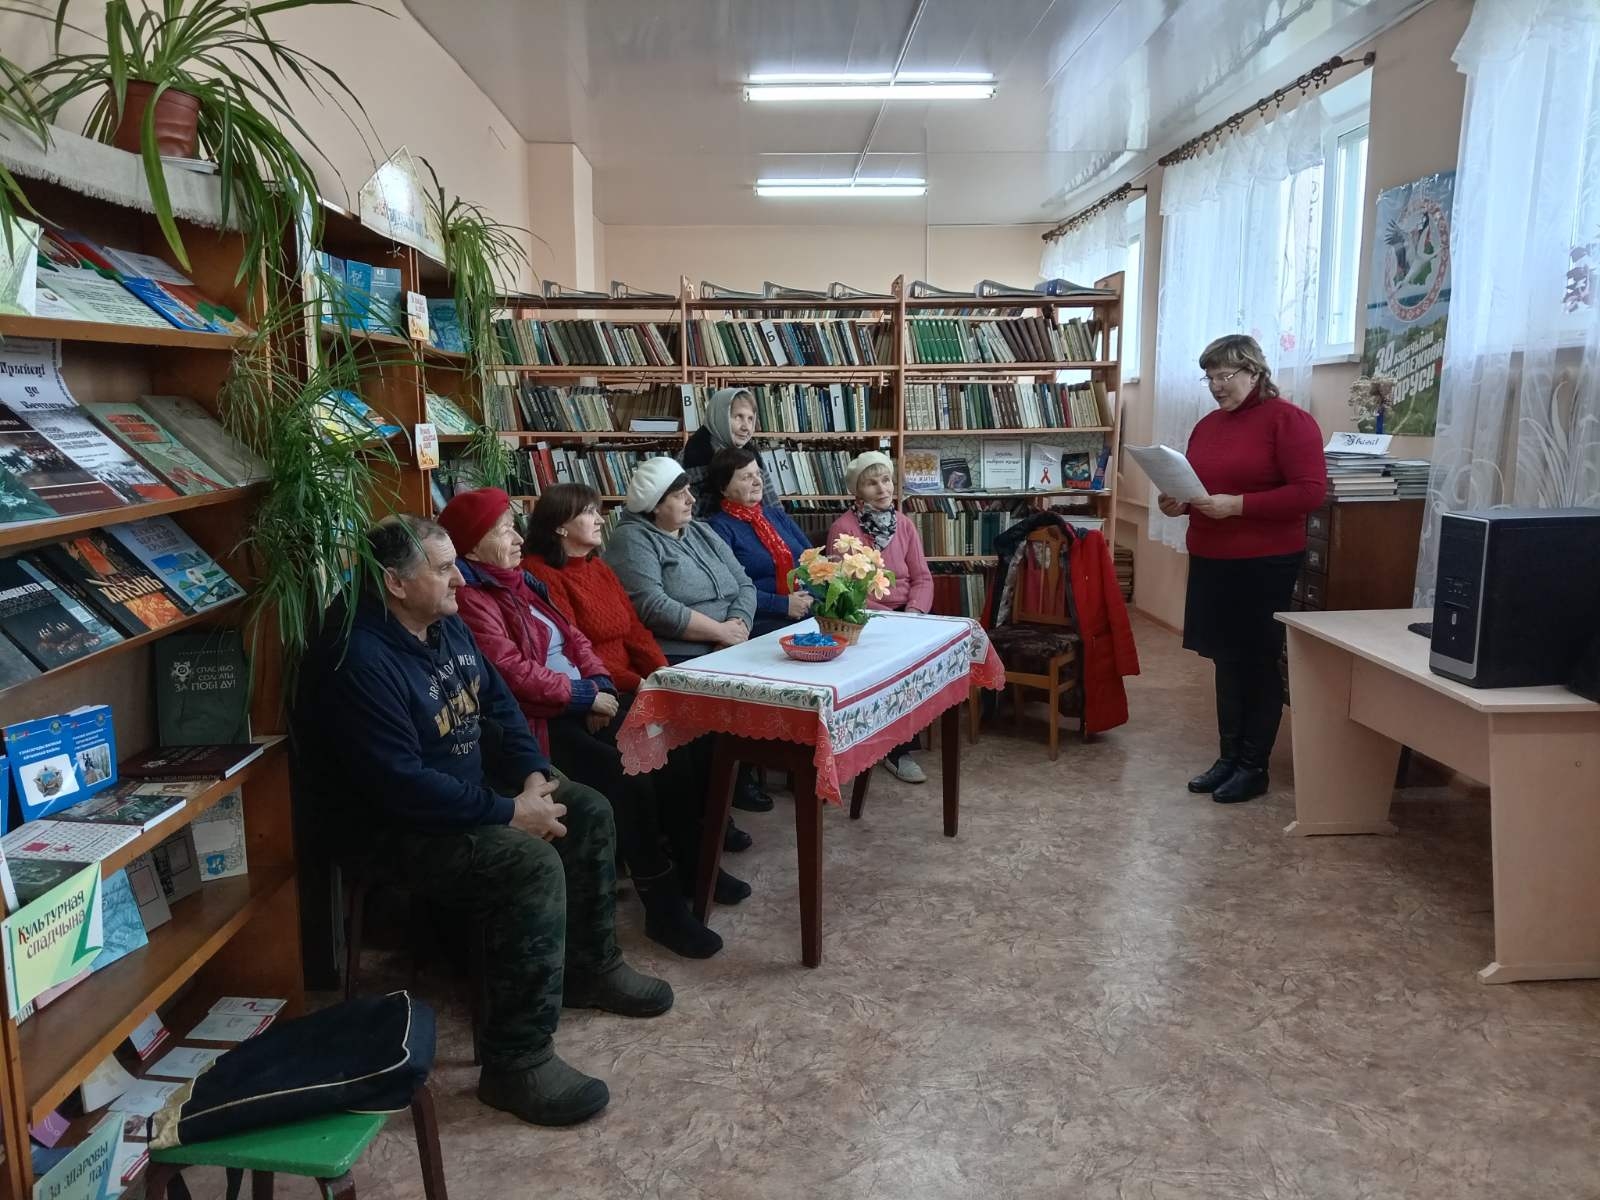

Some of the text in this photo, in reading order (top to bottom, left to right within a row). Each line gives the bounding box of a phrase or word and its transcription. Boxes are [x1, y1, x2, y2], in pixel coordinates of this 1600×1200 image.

[766, 331, 775, 342] Б
[1376, 340, 1395, 373] ЗА
[684, 395, 693, 406] В
[833, 395, 840, 407] Г
[556, 461, 567, 474] Д
[779, 460, 789, 471] К
[191, 679, 236, 692] ПОБЕДУ!
[18, 889, 86, 945] Культурная
[26, 909, 87, 959] спадчына
